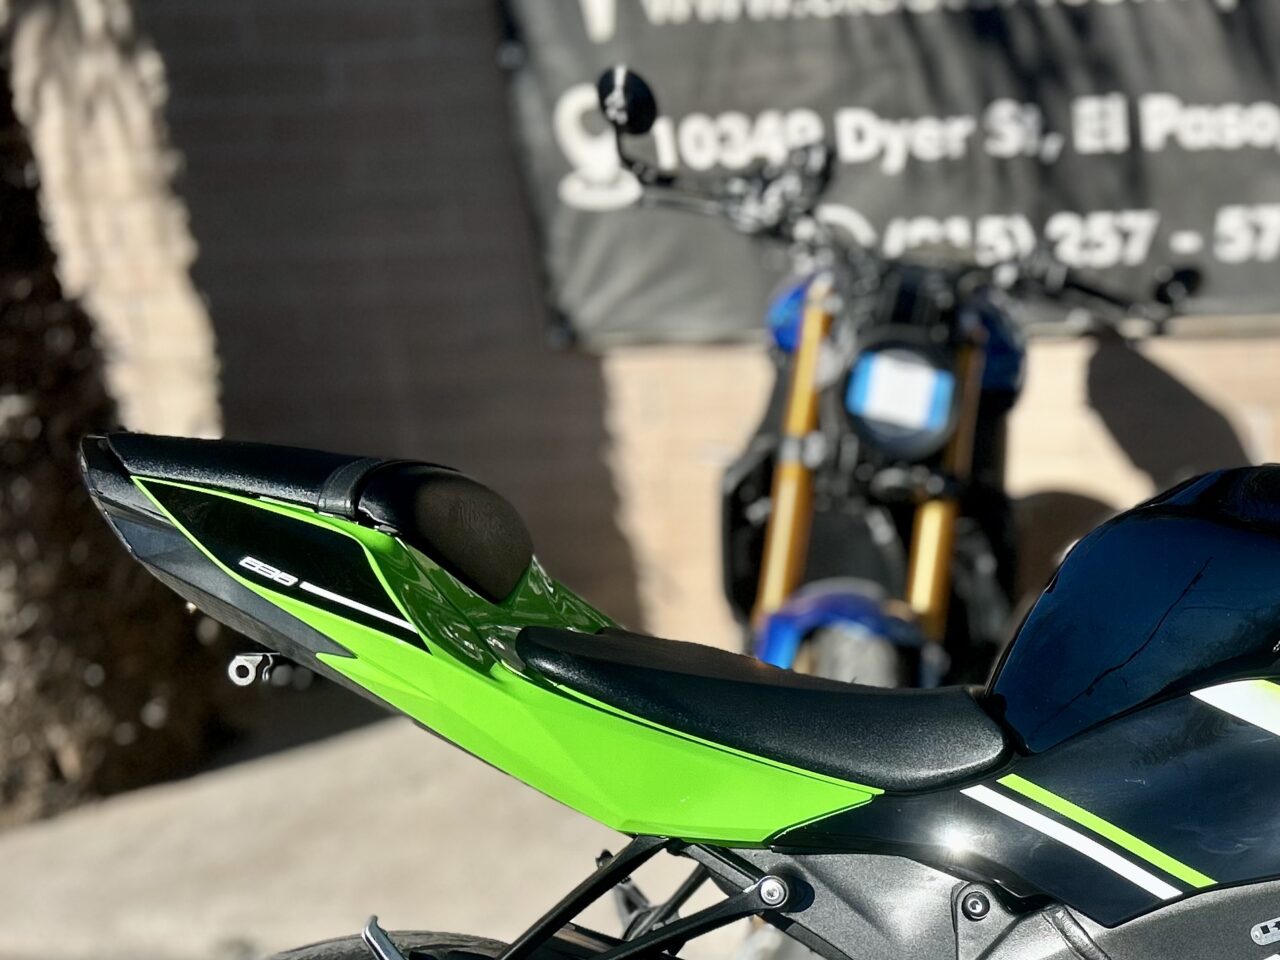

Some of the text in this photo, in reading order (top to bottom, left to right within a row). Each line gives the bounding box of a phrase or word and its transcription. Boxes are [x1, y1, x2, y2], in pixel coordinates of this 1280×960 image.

[834, 107, 977, 175] Dyer
[1071, 92, 1131, 154] El
[1045, 209, 1160, 268] 257
